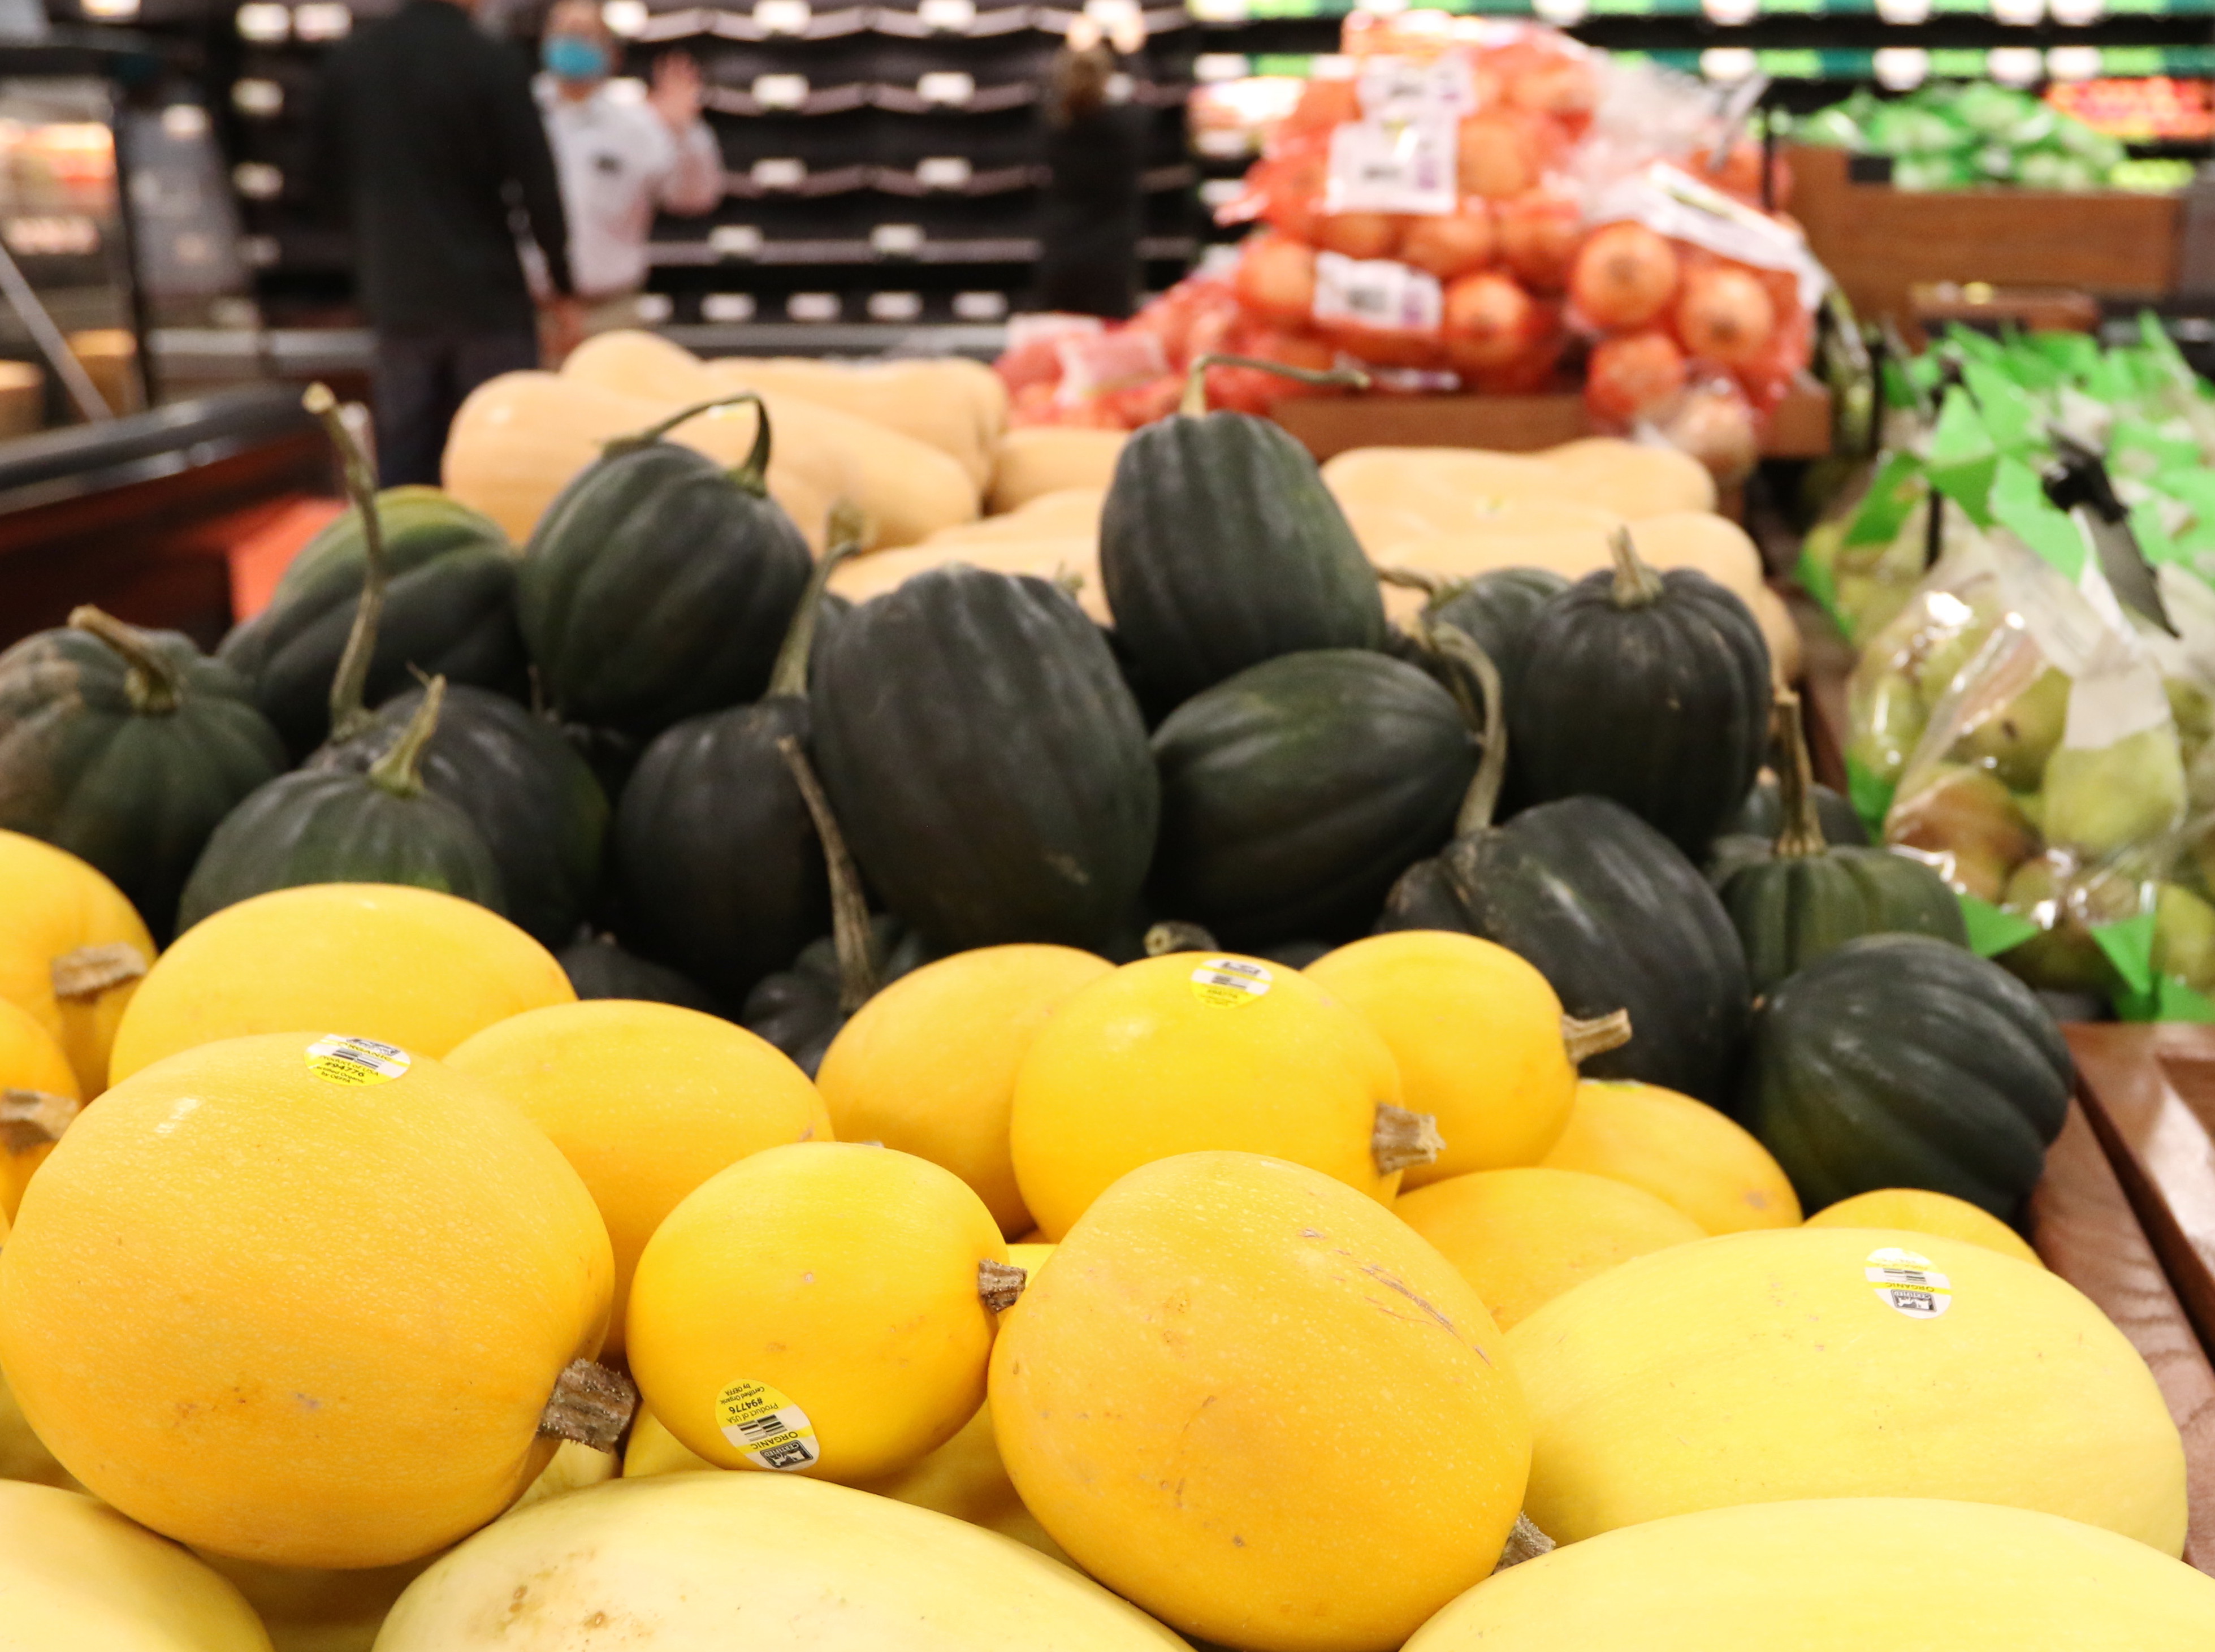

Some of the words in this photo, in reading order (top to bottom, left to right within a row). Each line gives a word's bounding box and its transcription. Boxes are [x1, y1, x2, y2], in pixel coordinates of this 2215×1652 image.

[325, 1062, 365, 1077] #94776
[1885, 1282, 1935, 1292] ORGANIC
[725, 1386, 743, 1396] OEFFA
[741, 1386, 765, 1398] Certified
[720, 1395, 741, 1405] Organic
[728, 1397, 763, 1413] #94776
[750, 1403, 778, 1417] Product
[726, 1415, 742, 1424] USA
[742, 1412, 749, 1421] of
[750, 1432, 798, 1450] ORGANIC
[764, 1442, 799, 1457] CERTIFIED
